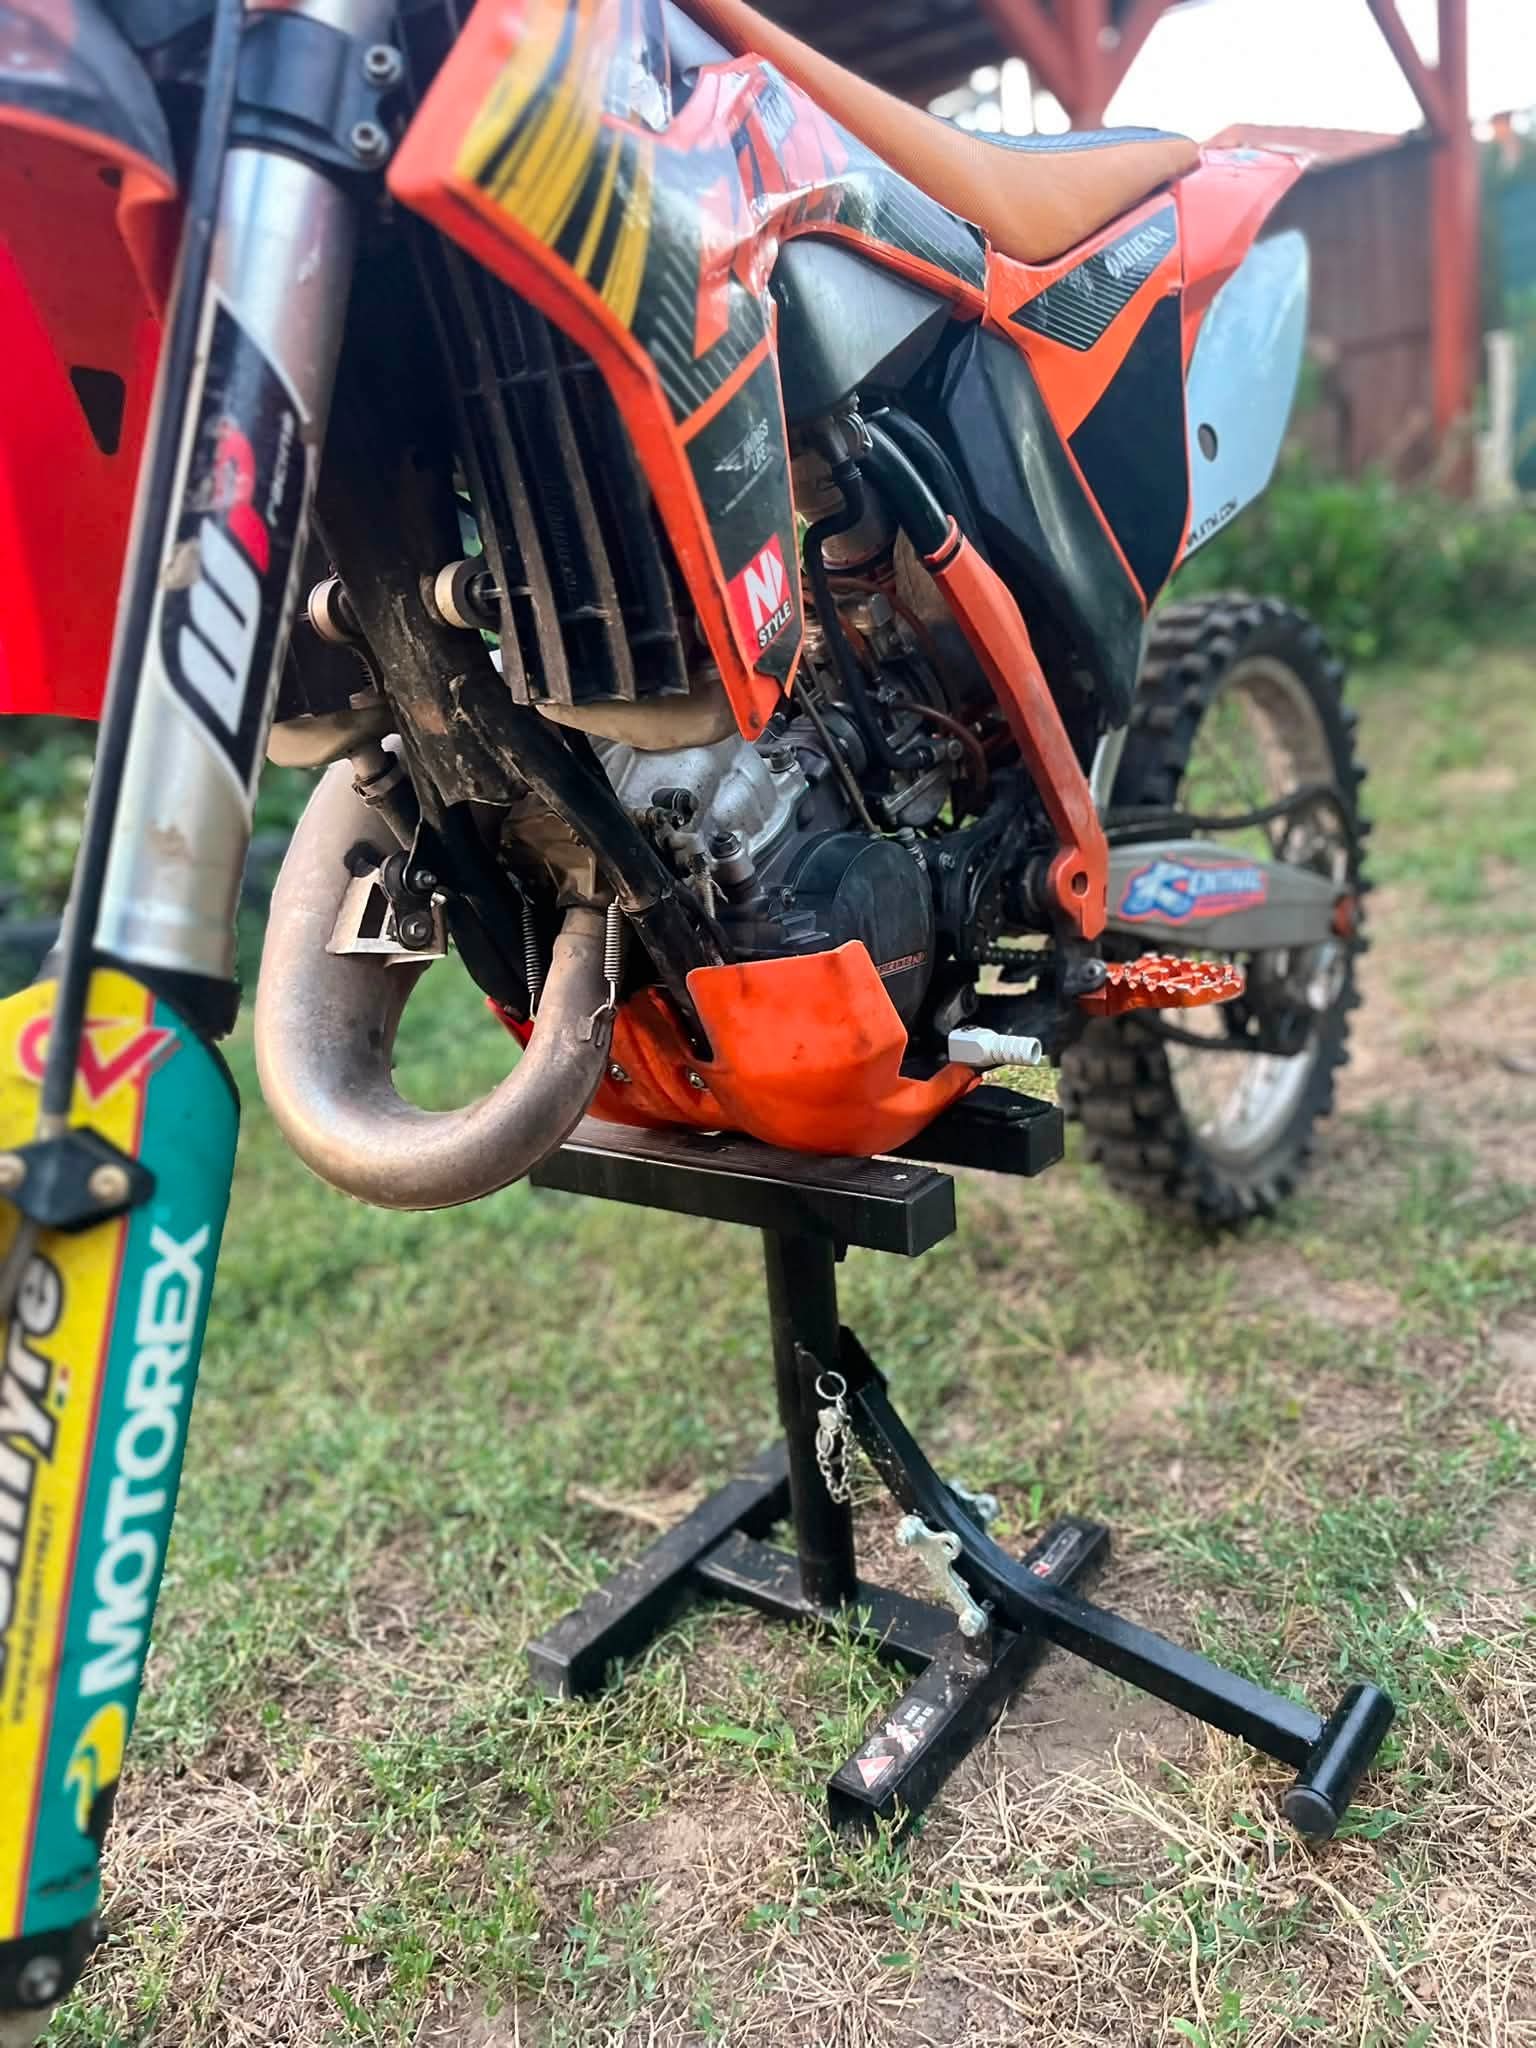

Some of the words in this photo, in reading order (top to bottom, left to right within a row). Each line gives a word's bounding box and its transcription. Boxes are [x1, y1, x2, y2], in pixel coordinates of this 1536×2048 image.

[1113, 226, 1170, 273] ATHENA
[758, 600, 792, 647] STYLE
[78, 1224, 210, 1697] MOTOREX
